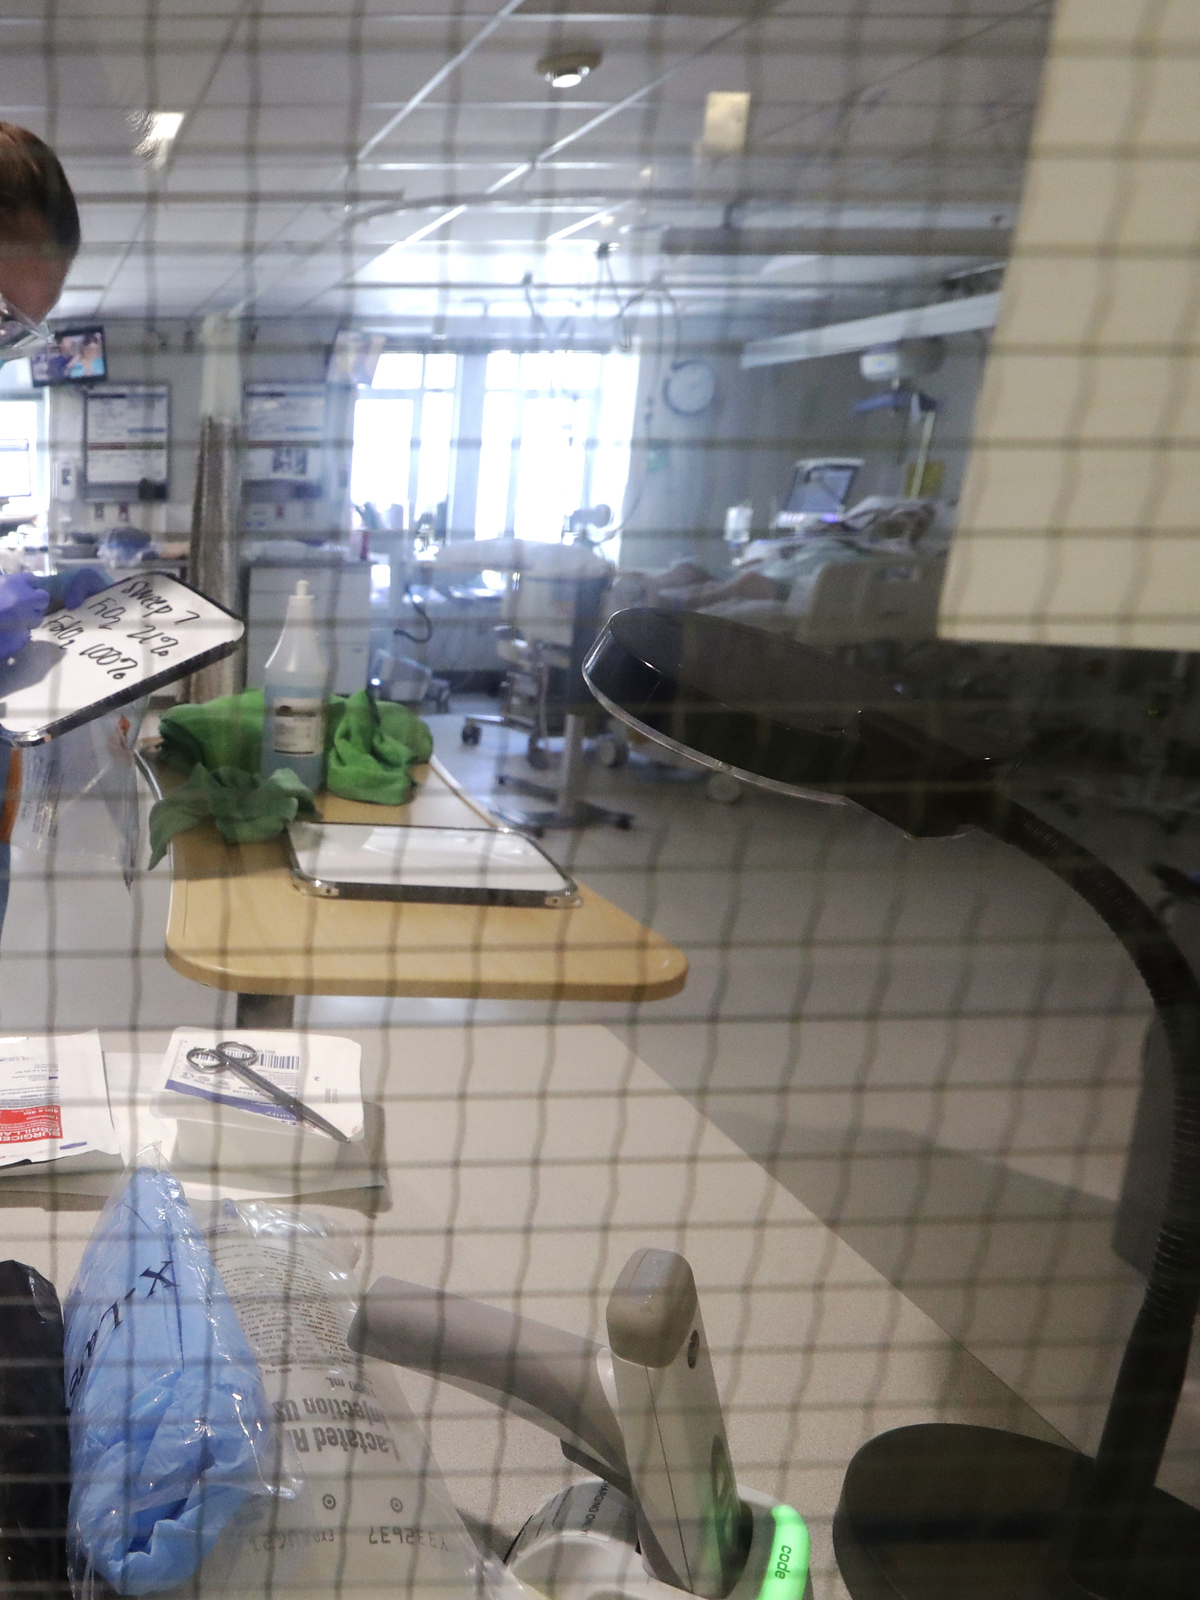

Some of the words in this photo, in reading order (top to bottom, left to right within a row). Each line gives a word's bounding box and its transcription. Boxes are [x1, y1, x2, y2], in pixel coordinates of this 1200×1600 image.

[120, 580, 173, 616] Sweep
[127, 624, 180, 658] 21%
[79, 642, 139, 681] 100%
[302, 1398, 387, 1430] Injection
[311, 1426, 400, 1462] Lactated
[773, 1544, 792, 1580] code
